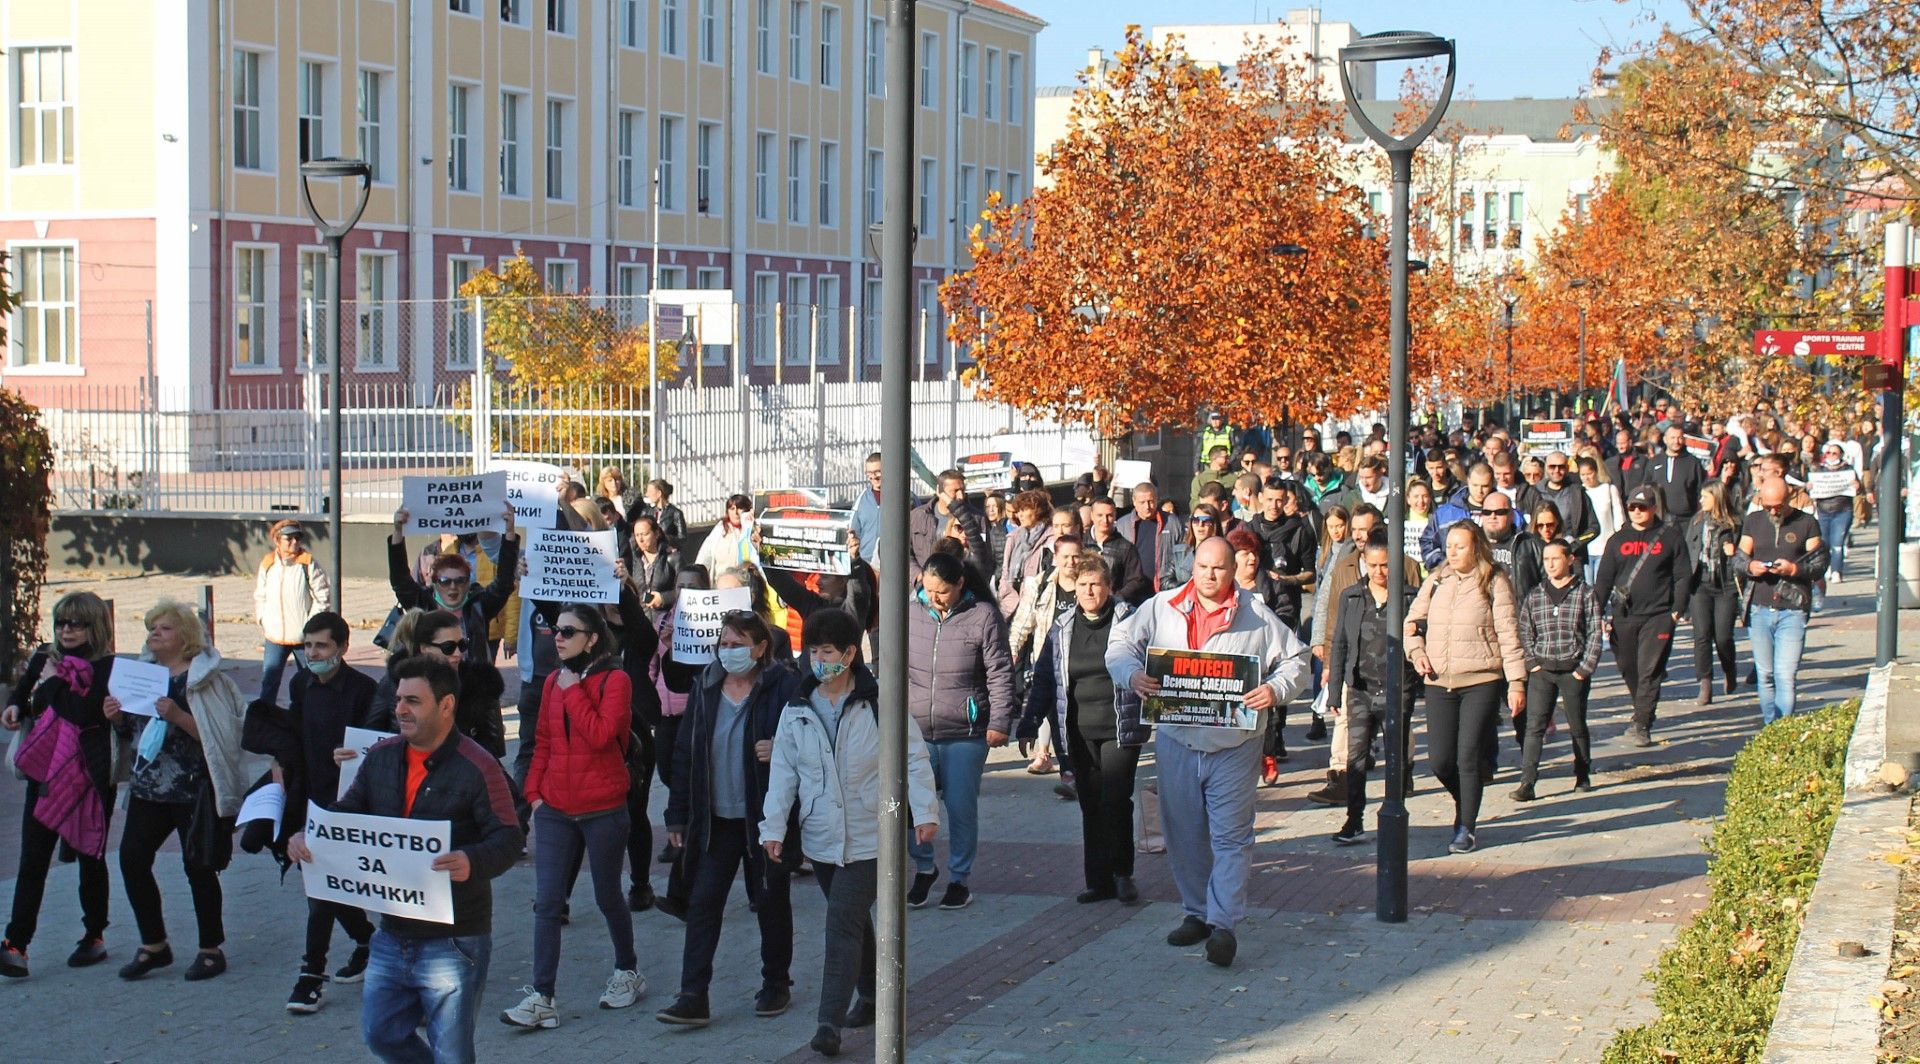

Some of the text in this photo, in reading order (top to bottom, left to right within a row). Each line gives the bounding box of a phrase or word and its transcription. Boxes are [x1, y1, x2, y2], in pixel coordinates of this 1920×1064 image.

[1836, 343, 1865, 351] CENTRE
[427, 480, 483, 492] РАВНИ
[427, 493, 482, 505] ПРАВА
[508, 489, 523, 499] ЗА
[444, 507, 464, 517] ЗА
[513, 506, 542, 518] ЧКИ!
[418, 517, 490, 529] ВСИЧКИ!
[542, 533, 590, 543] ВСИЧКИ
[533, 544, 603, 555] ЗАЕДНО ЗА:
[543, 556, 594, 566] ЗДРАВЕ,
[544, 567, 596, 577] РАБОТА,
[542, 577, 600, 588] БЪДЕЩЕ,
[533, 588, 608, 599] СИГУРНОСТ!
[687, 596, 719, 606] ДА СЕ
[680, 611, 727, 622] ПРИЗНАЯ
[682, 644, 716, 654] АНТИТ
[1173, 656, 1234, 678] ПРОТЕСТ!
[1202, 677, 1244, 693] ЗАЕДНО!
[308, 819, 442, 853] РАВЕНСТВО
[358, 856, 387, 875] ЗА
[326, 875, 425, 905] ВСИЧКИ!
